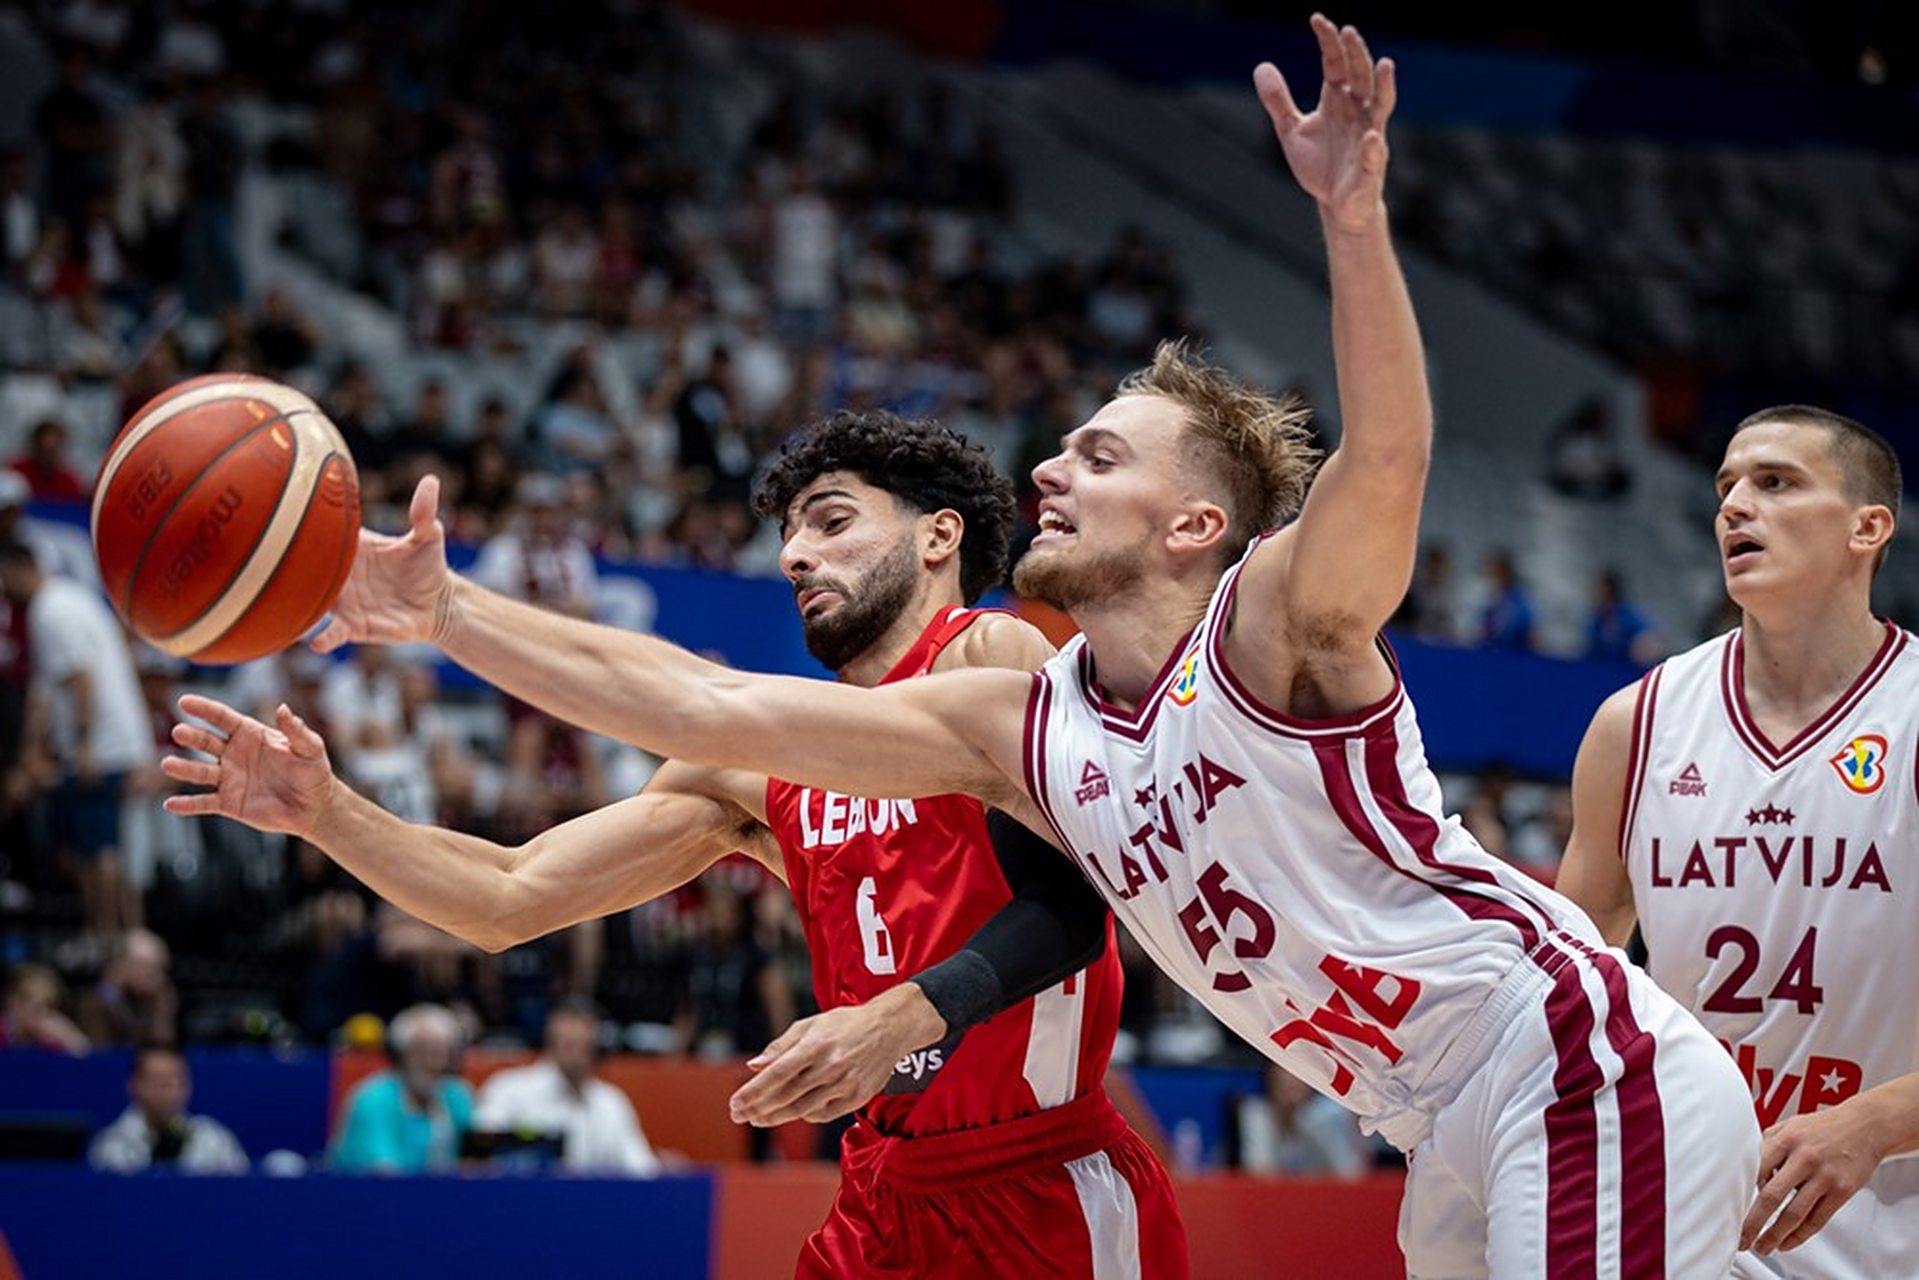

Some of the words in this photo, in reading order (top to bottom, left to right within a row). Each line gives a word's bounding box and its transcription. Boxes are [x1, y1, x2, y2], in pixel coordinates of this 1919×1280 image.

[130, 460, 172, 521] FIBA
[158, 484, 243, 597] molten
[1668, 780, 1707, 796] PEAK
[1651, 836, 1892, 893] LATVIJA
[855, 876, 897, 975] 6
[1178, 860, 1276, 992] 55
[1702, 924, 1823, 1015] 24
